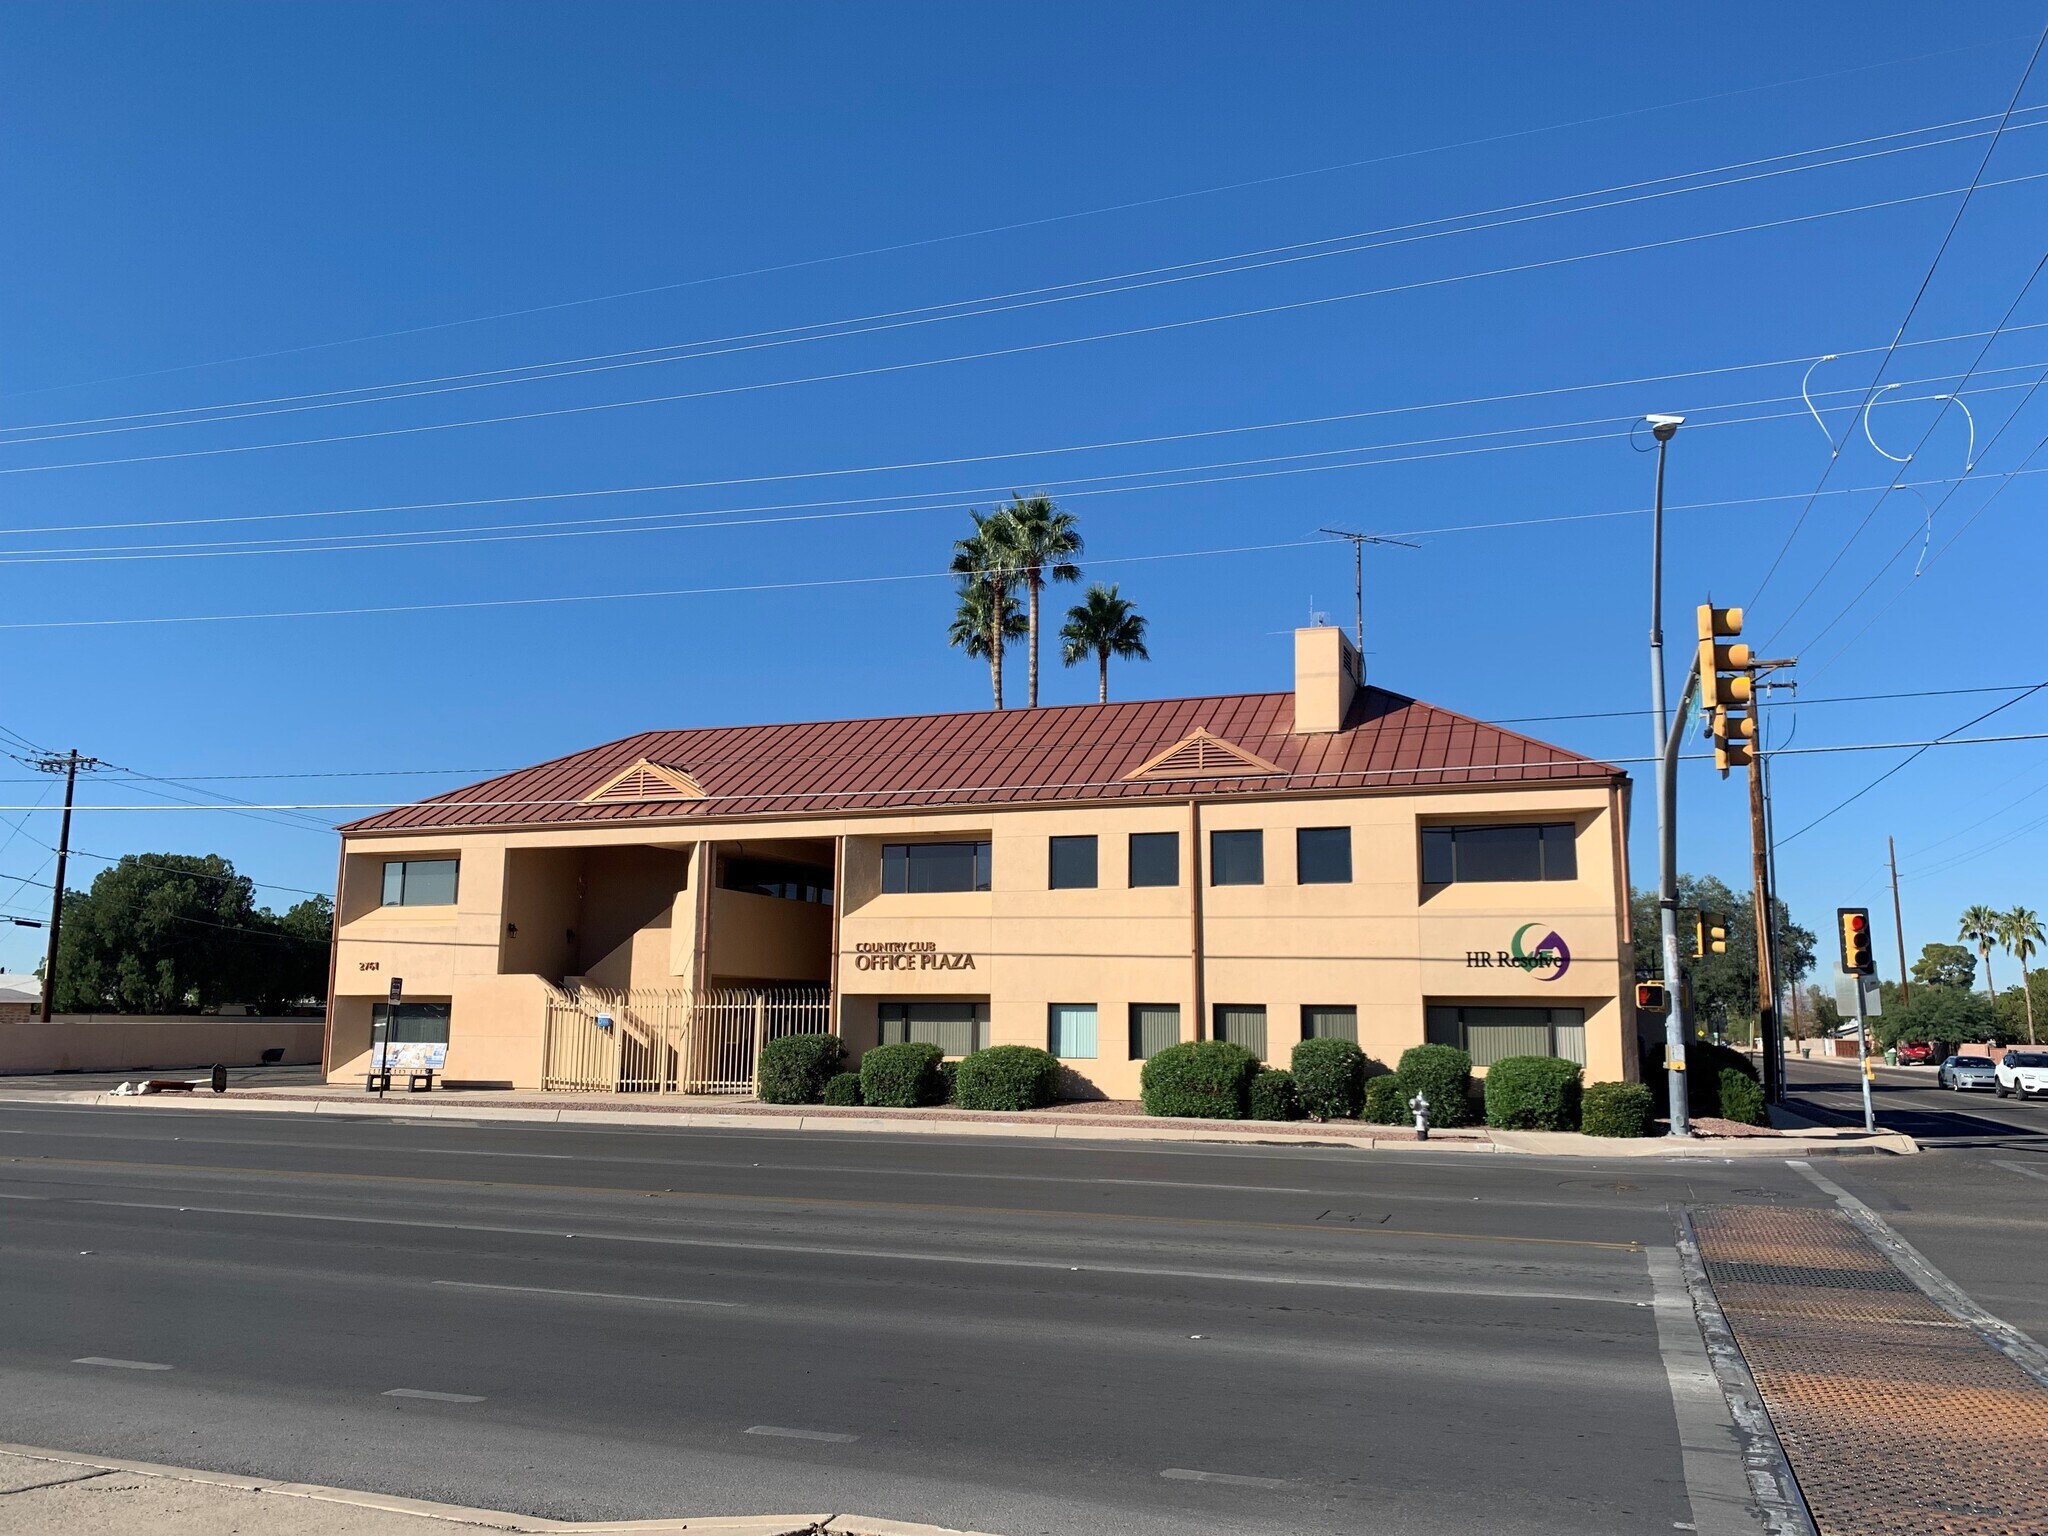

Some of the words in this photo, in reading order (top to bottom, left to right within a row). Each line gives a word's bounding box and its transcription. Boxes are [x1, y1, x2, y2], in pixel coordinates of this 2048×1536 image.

[856, 942, 907, 953] COUNTRY
[908, 942, 936, 952] CLUB
[855, 954, 916, 971] OFFICE
[920, 953, 976, 970] PLAZA
[1466, 952, 1493, 968] HR
[1497, 952, 1563, 968] Resolve
